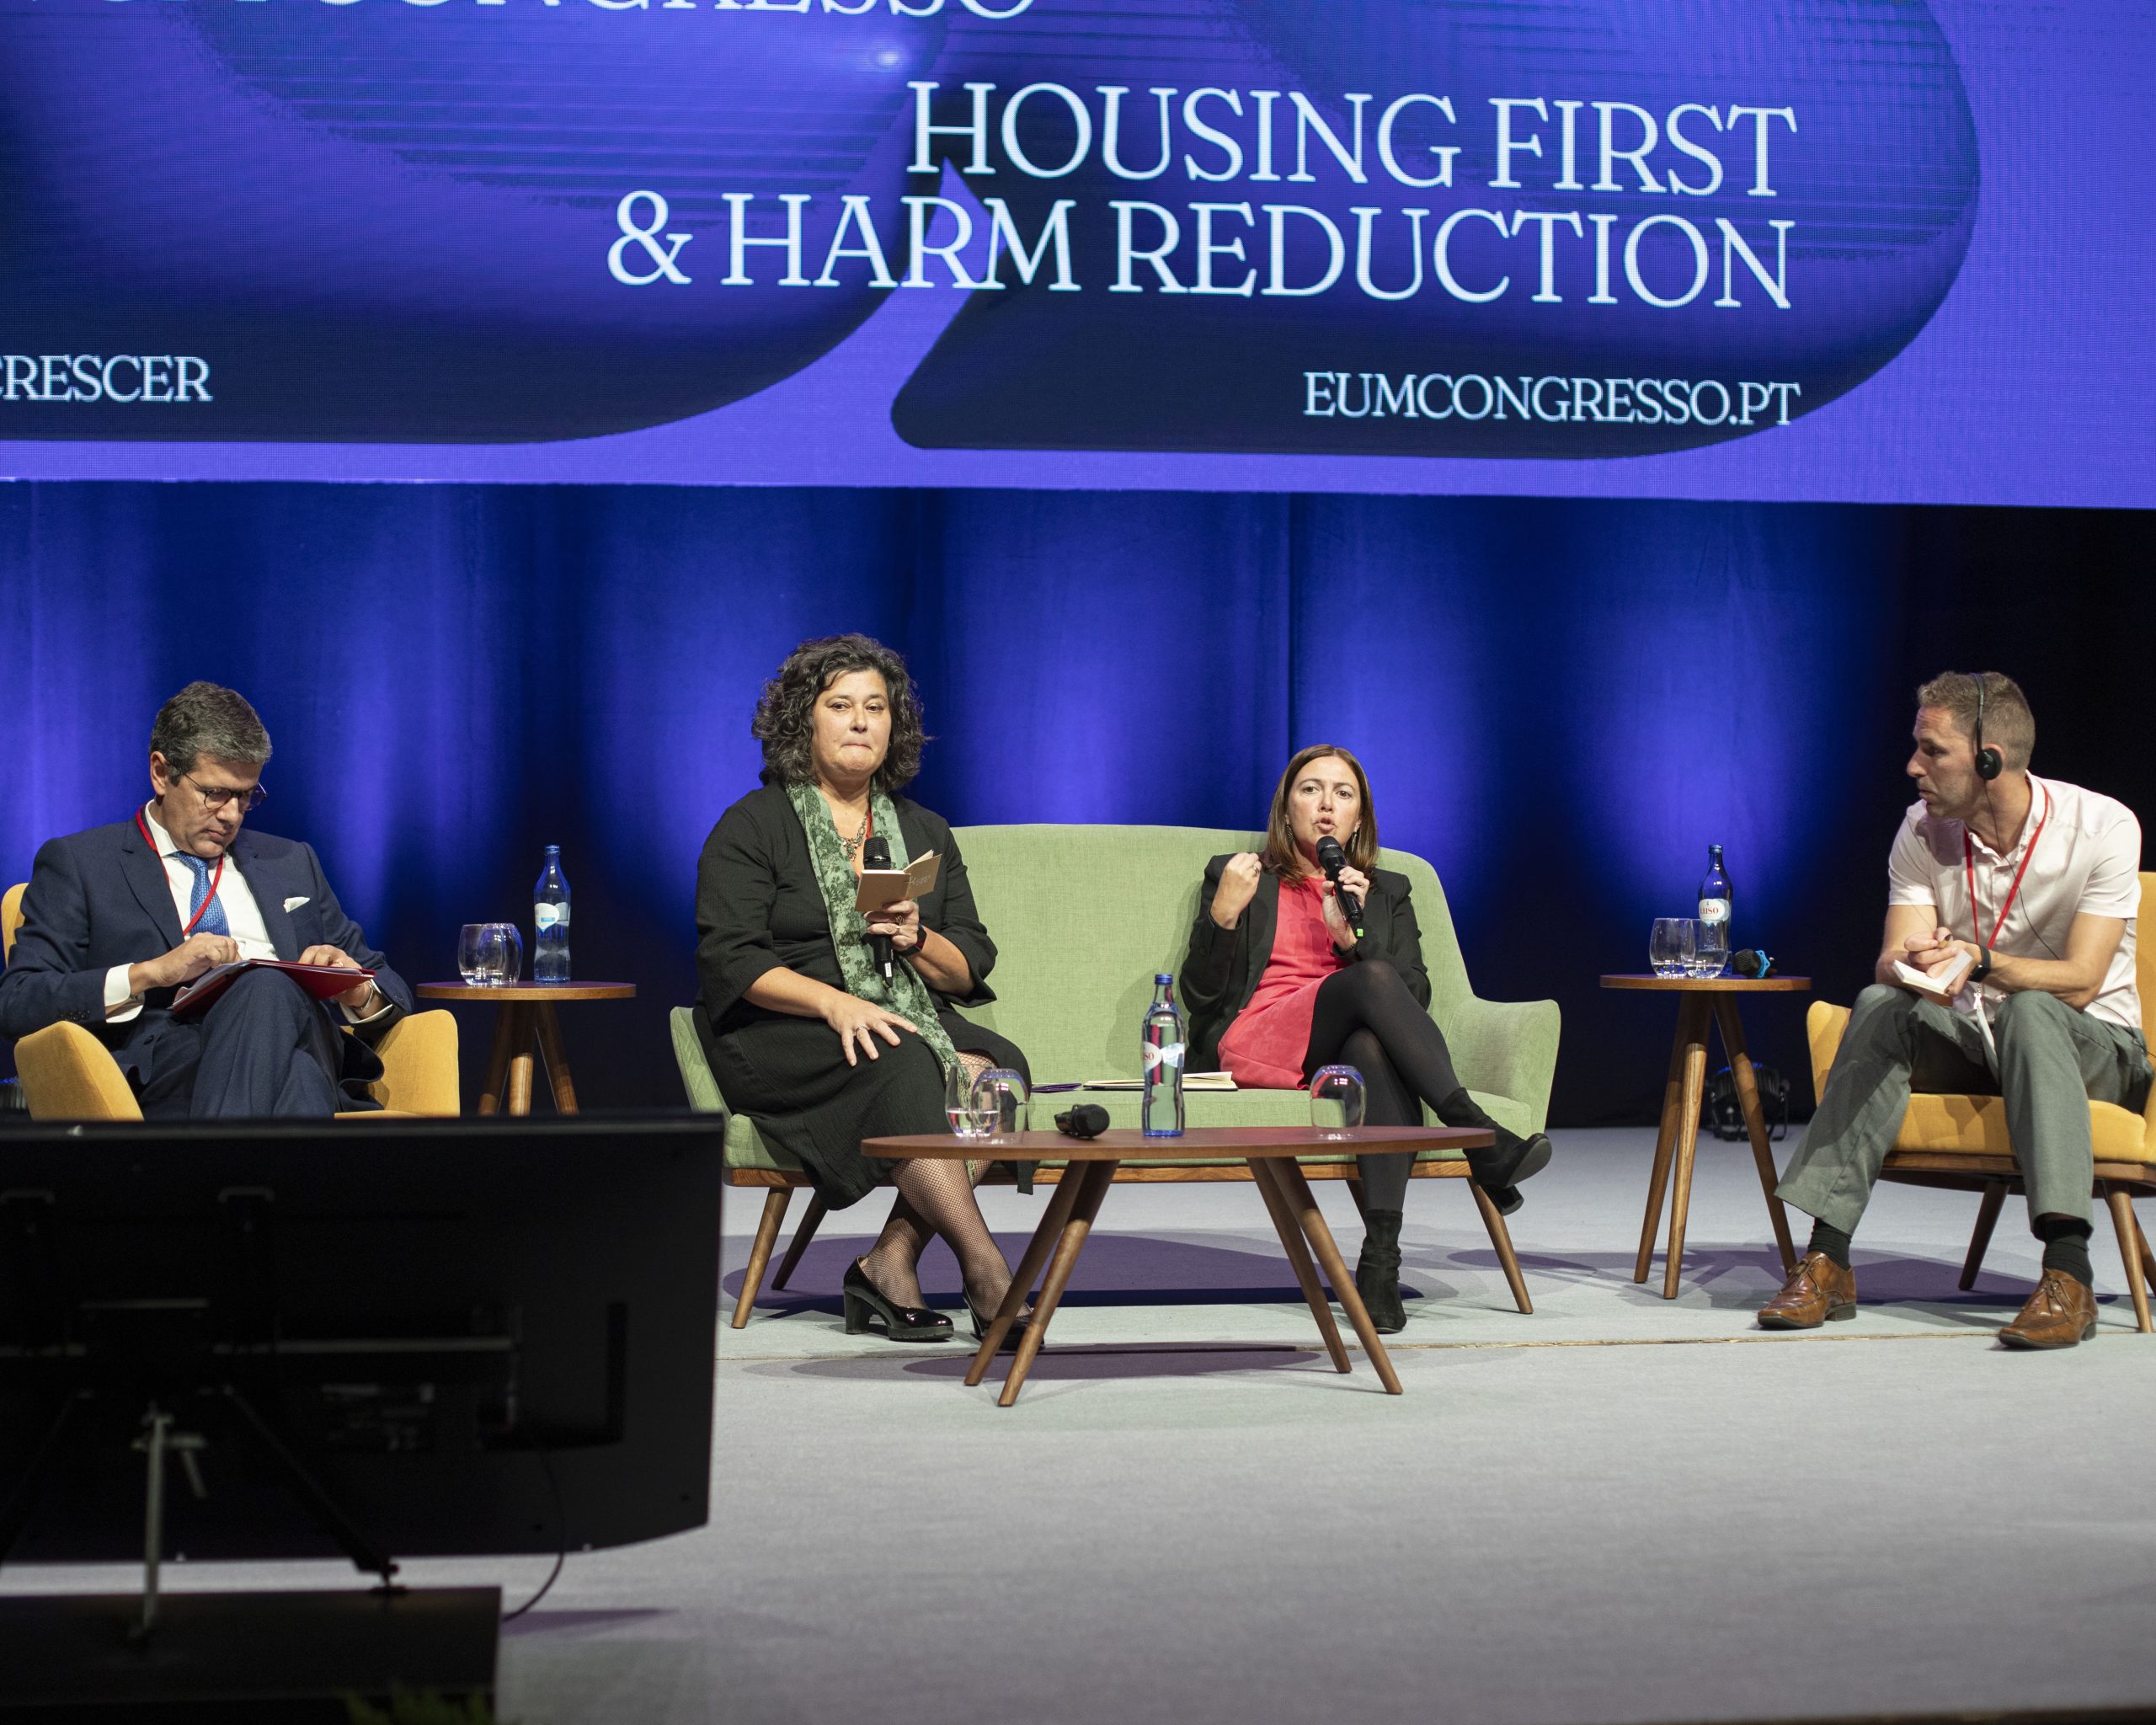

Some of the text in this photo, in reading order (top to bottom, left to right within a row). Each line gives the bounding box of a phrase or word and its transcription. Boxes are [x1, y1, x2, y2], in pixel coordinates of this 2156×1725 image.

[906, 80, 1799, 197] HOUSING FIRST
[606, 189, 1797, 309] & HARM REDUCTION
[0, 354, 213, 402] RESCER
[1304, 371, 1802, 427] EUMCONGRESSO.PT
